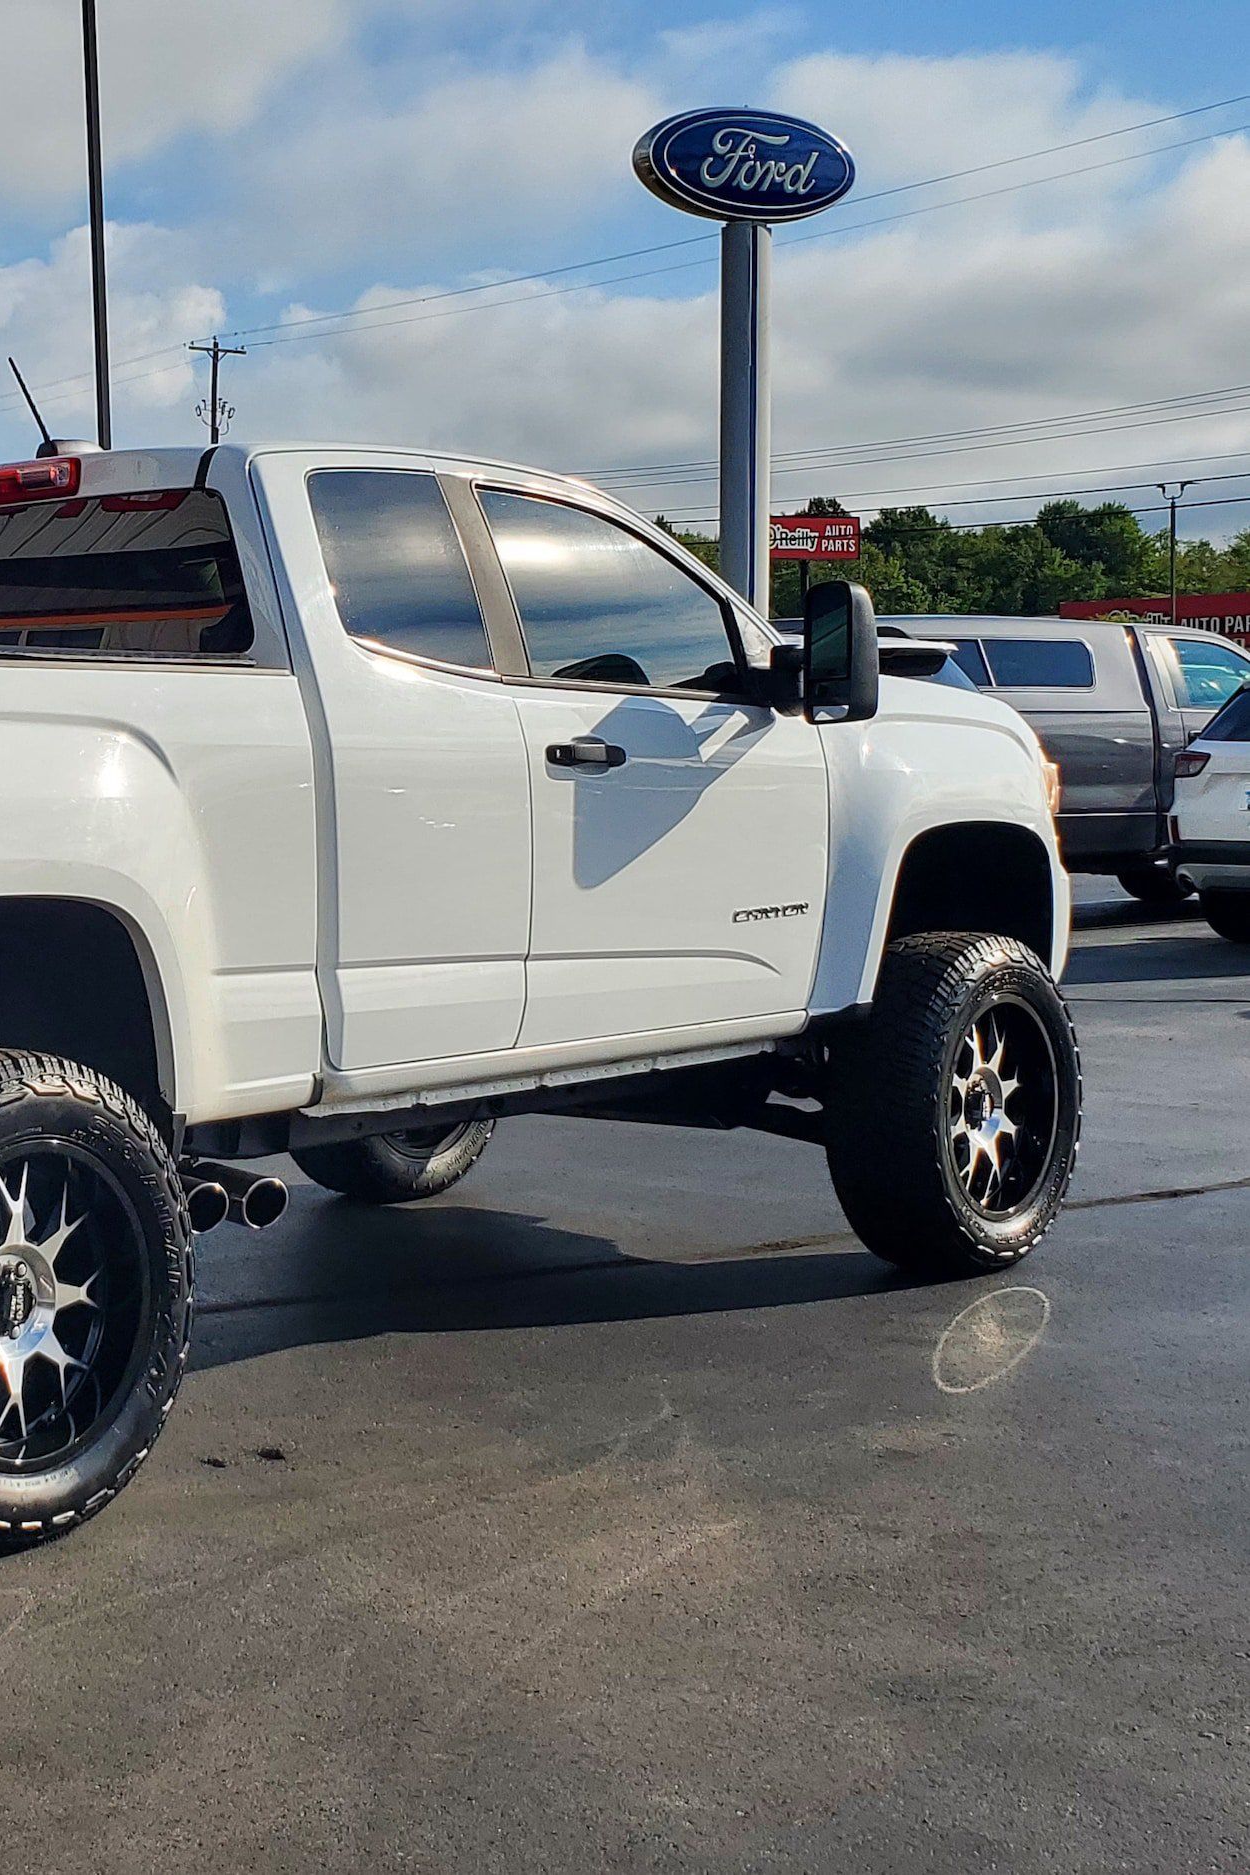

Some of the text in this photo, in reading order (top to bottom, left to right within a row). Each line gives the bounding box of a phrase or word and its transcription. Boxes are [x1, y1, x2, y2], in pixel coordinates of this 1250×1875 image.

[701, 128, 819, 194] Ford
[825, 525, 854, 538] AUTO
[821, 539, 856, 552] PARTS
